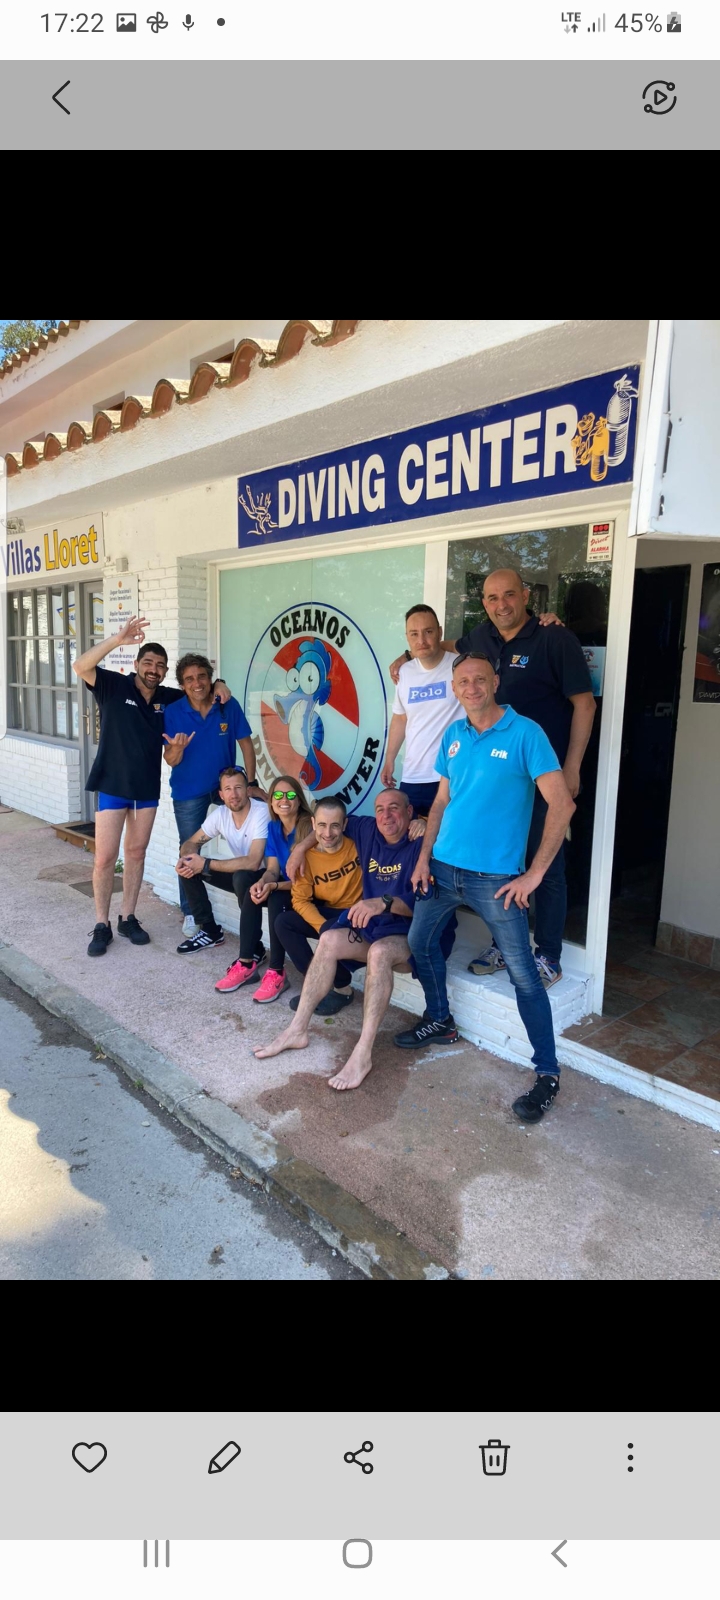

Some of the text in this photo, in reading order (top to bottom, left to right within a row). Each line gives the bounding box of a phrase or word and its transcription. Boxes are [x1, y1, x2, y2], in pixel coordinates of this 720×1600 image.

[277, 403, 578, 529] DIVING CENTER
[44, 524, 99, 571] Lloret
[270, 608, 350, 649] OCEANOS
[410, 688, 443, 700] Polo
[490, 748, 508, 759] Erik
